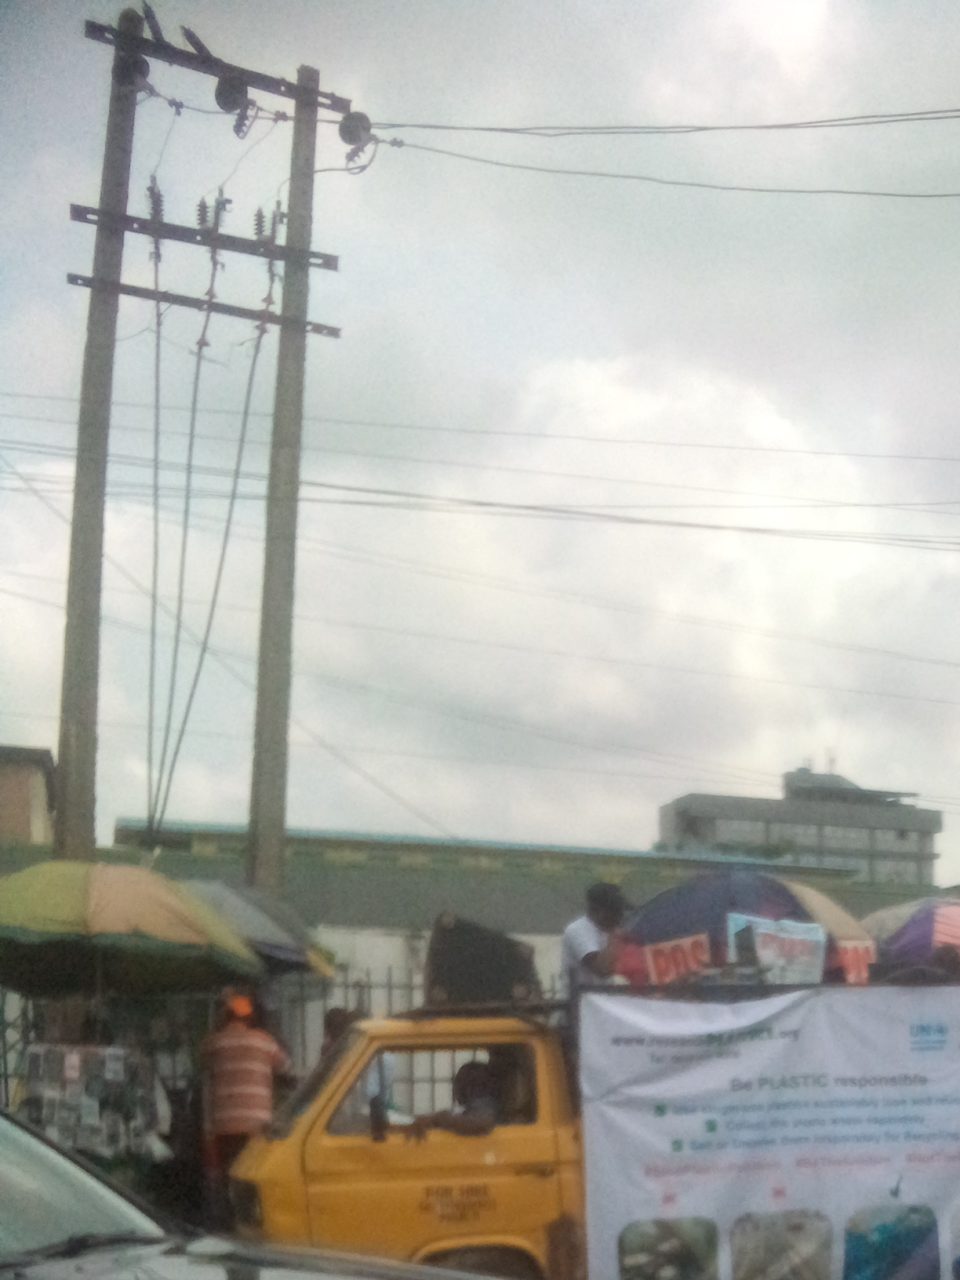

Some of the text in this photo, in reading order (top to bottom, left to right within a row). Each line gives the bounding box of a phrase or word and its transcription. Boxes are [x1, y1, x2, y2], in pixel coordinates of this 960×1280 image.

[730, 1073, 928, 1092] Be PLASTIC responsible
